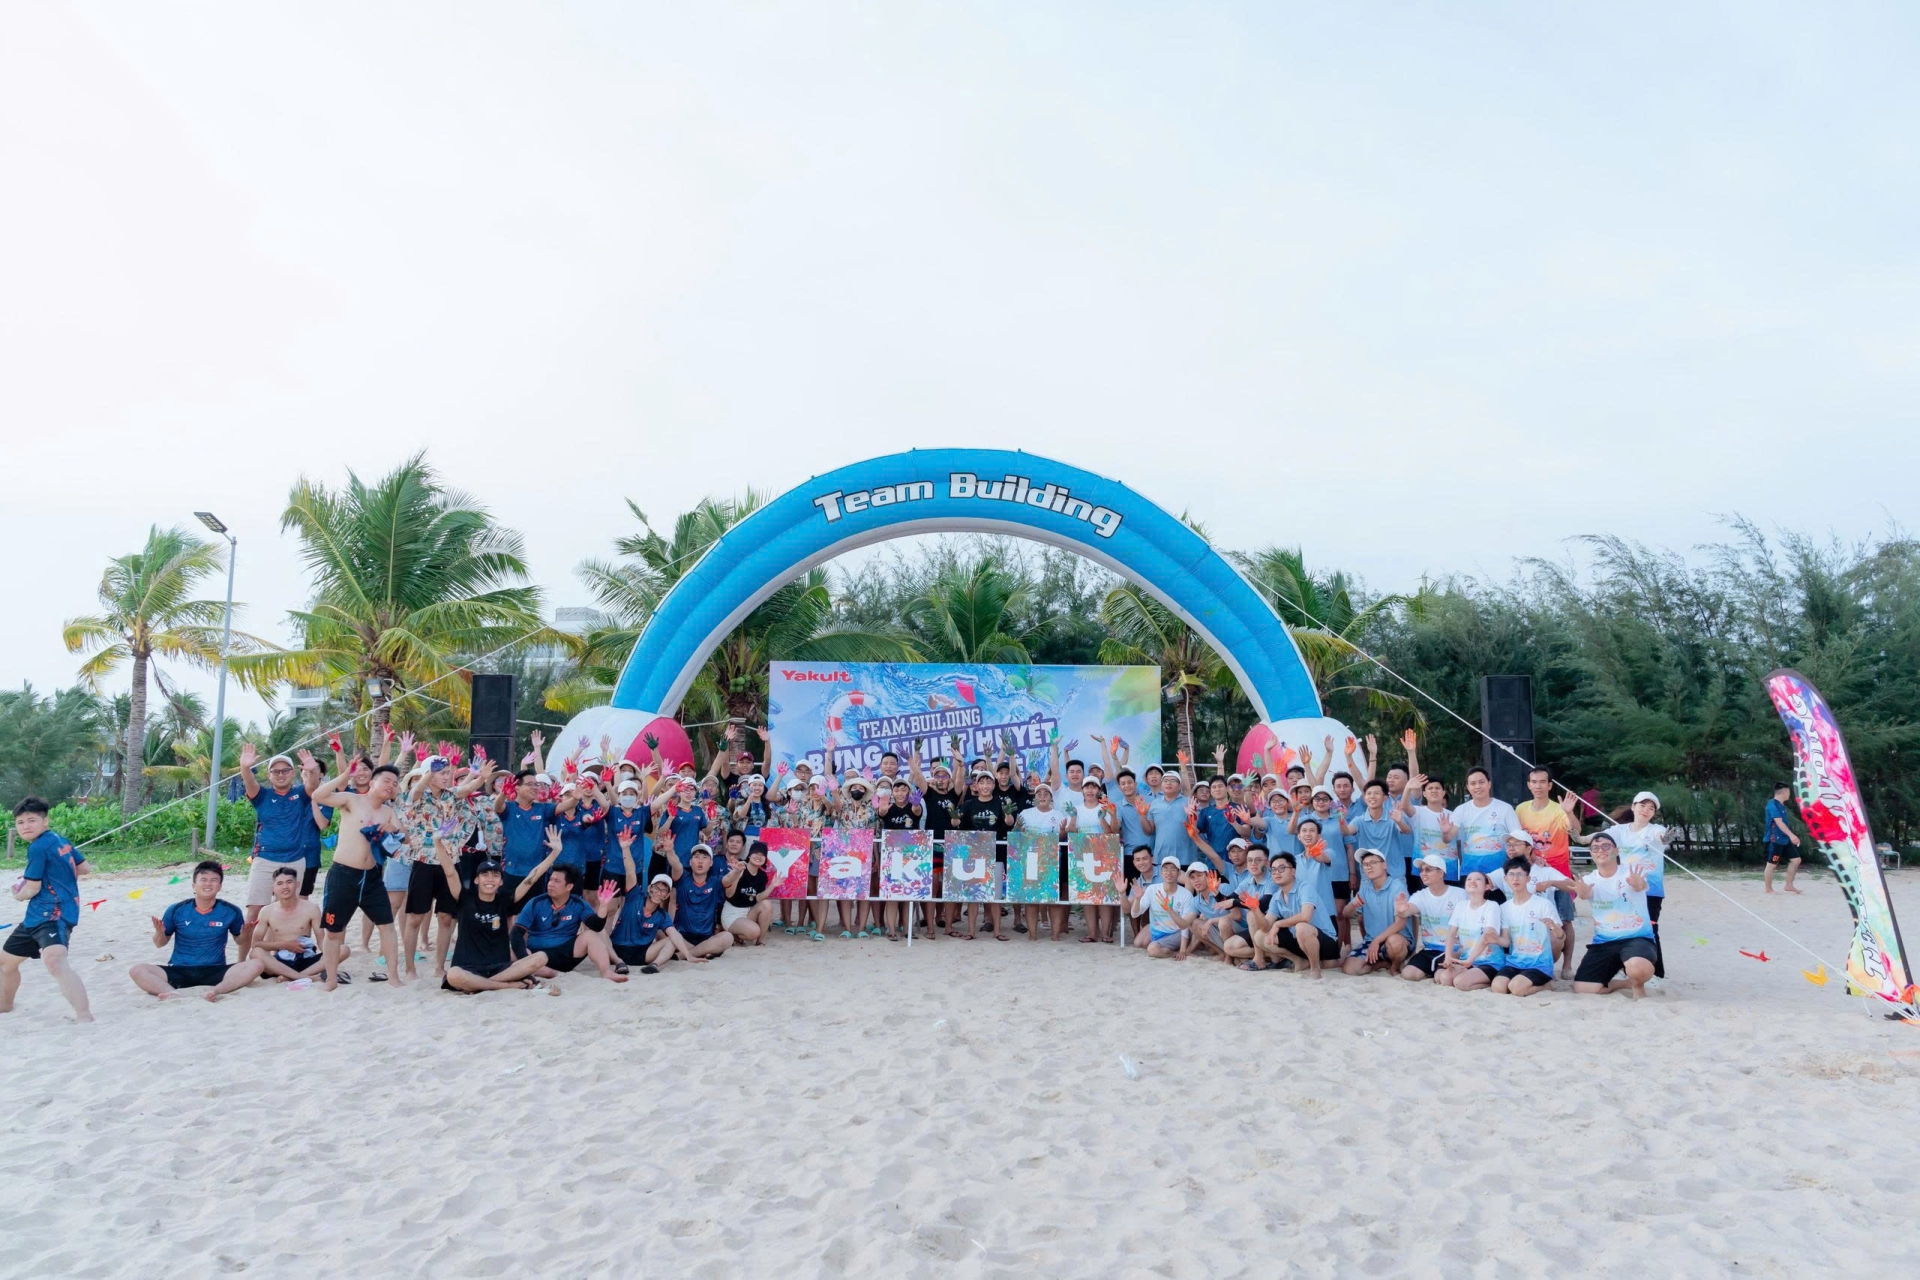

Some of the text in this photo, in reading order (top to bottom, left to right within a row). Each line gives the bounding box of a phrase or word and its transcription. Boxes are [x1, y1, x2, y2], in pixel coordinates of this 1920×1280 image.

[813, 472, 1123, 538] Team Building
[781, 669, 852, 682] Yakult
[859, 708, 981, 739] TEAM BUILDING
[767, 849, 1112, 884] Yakult
